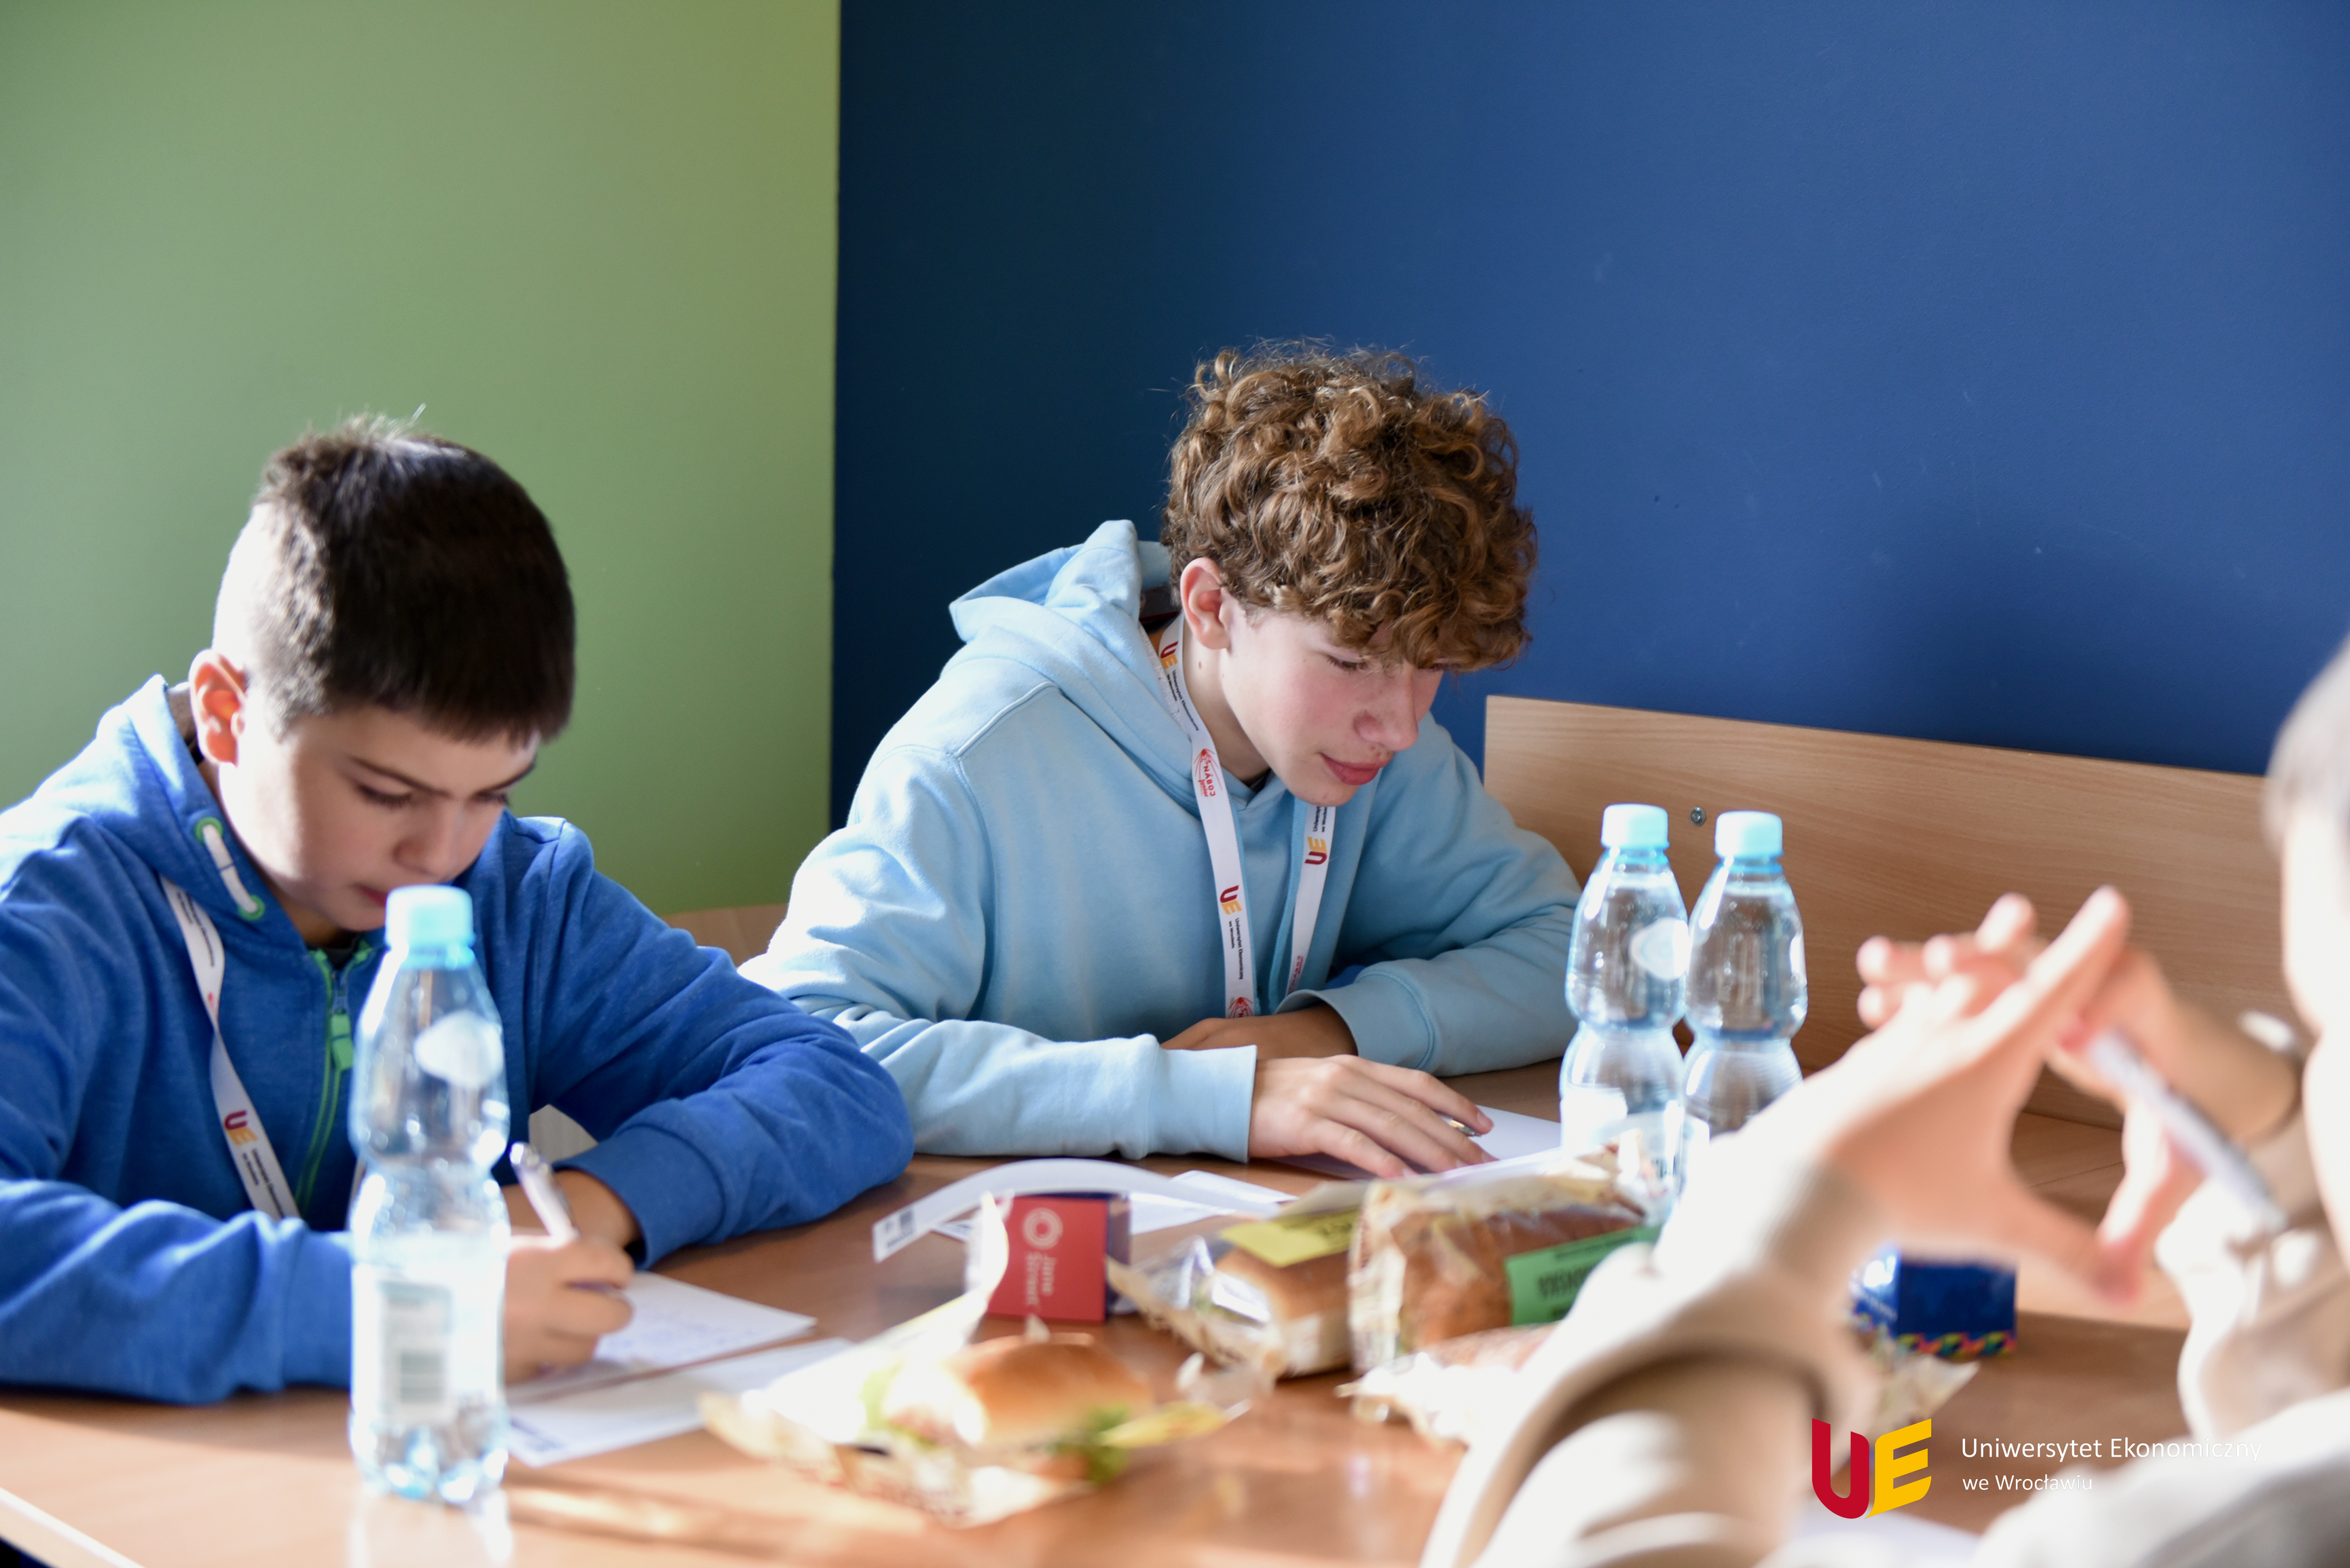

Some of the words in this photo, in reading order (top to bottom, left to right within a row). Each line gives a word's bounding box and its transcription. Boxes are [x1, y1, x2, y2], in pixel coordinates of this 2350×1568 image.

[1160, 641, 1179, 669] UE
[1312, 806, 1321, 832] Uniwersyt
[1304, 836, 1327, 865] UE
[1220, 885, 1243, 915] UE
[224, 1110, 257, 1145] UE
